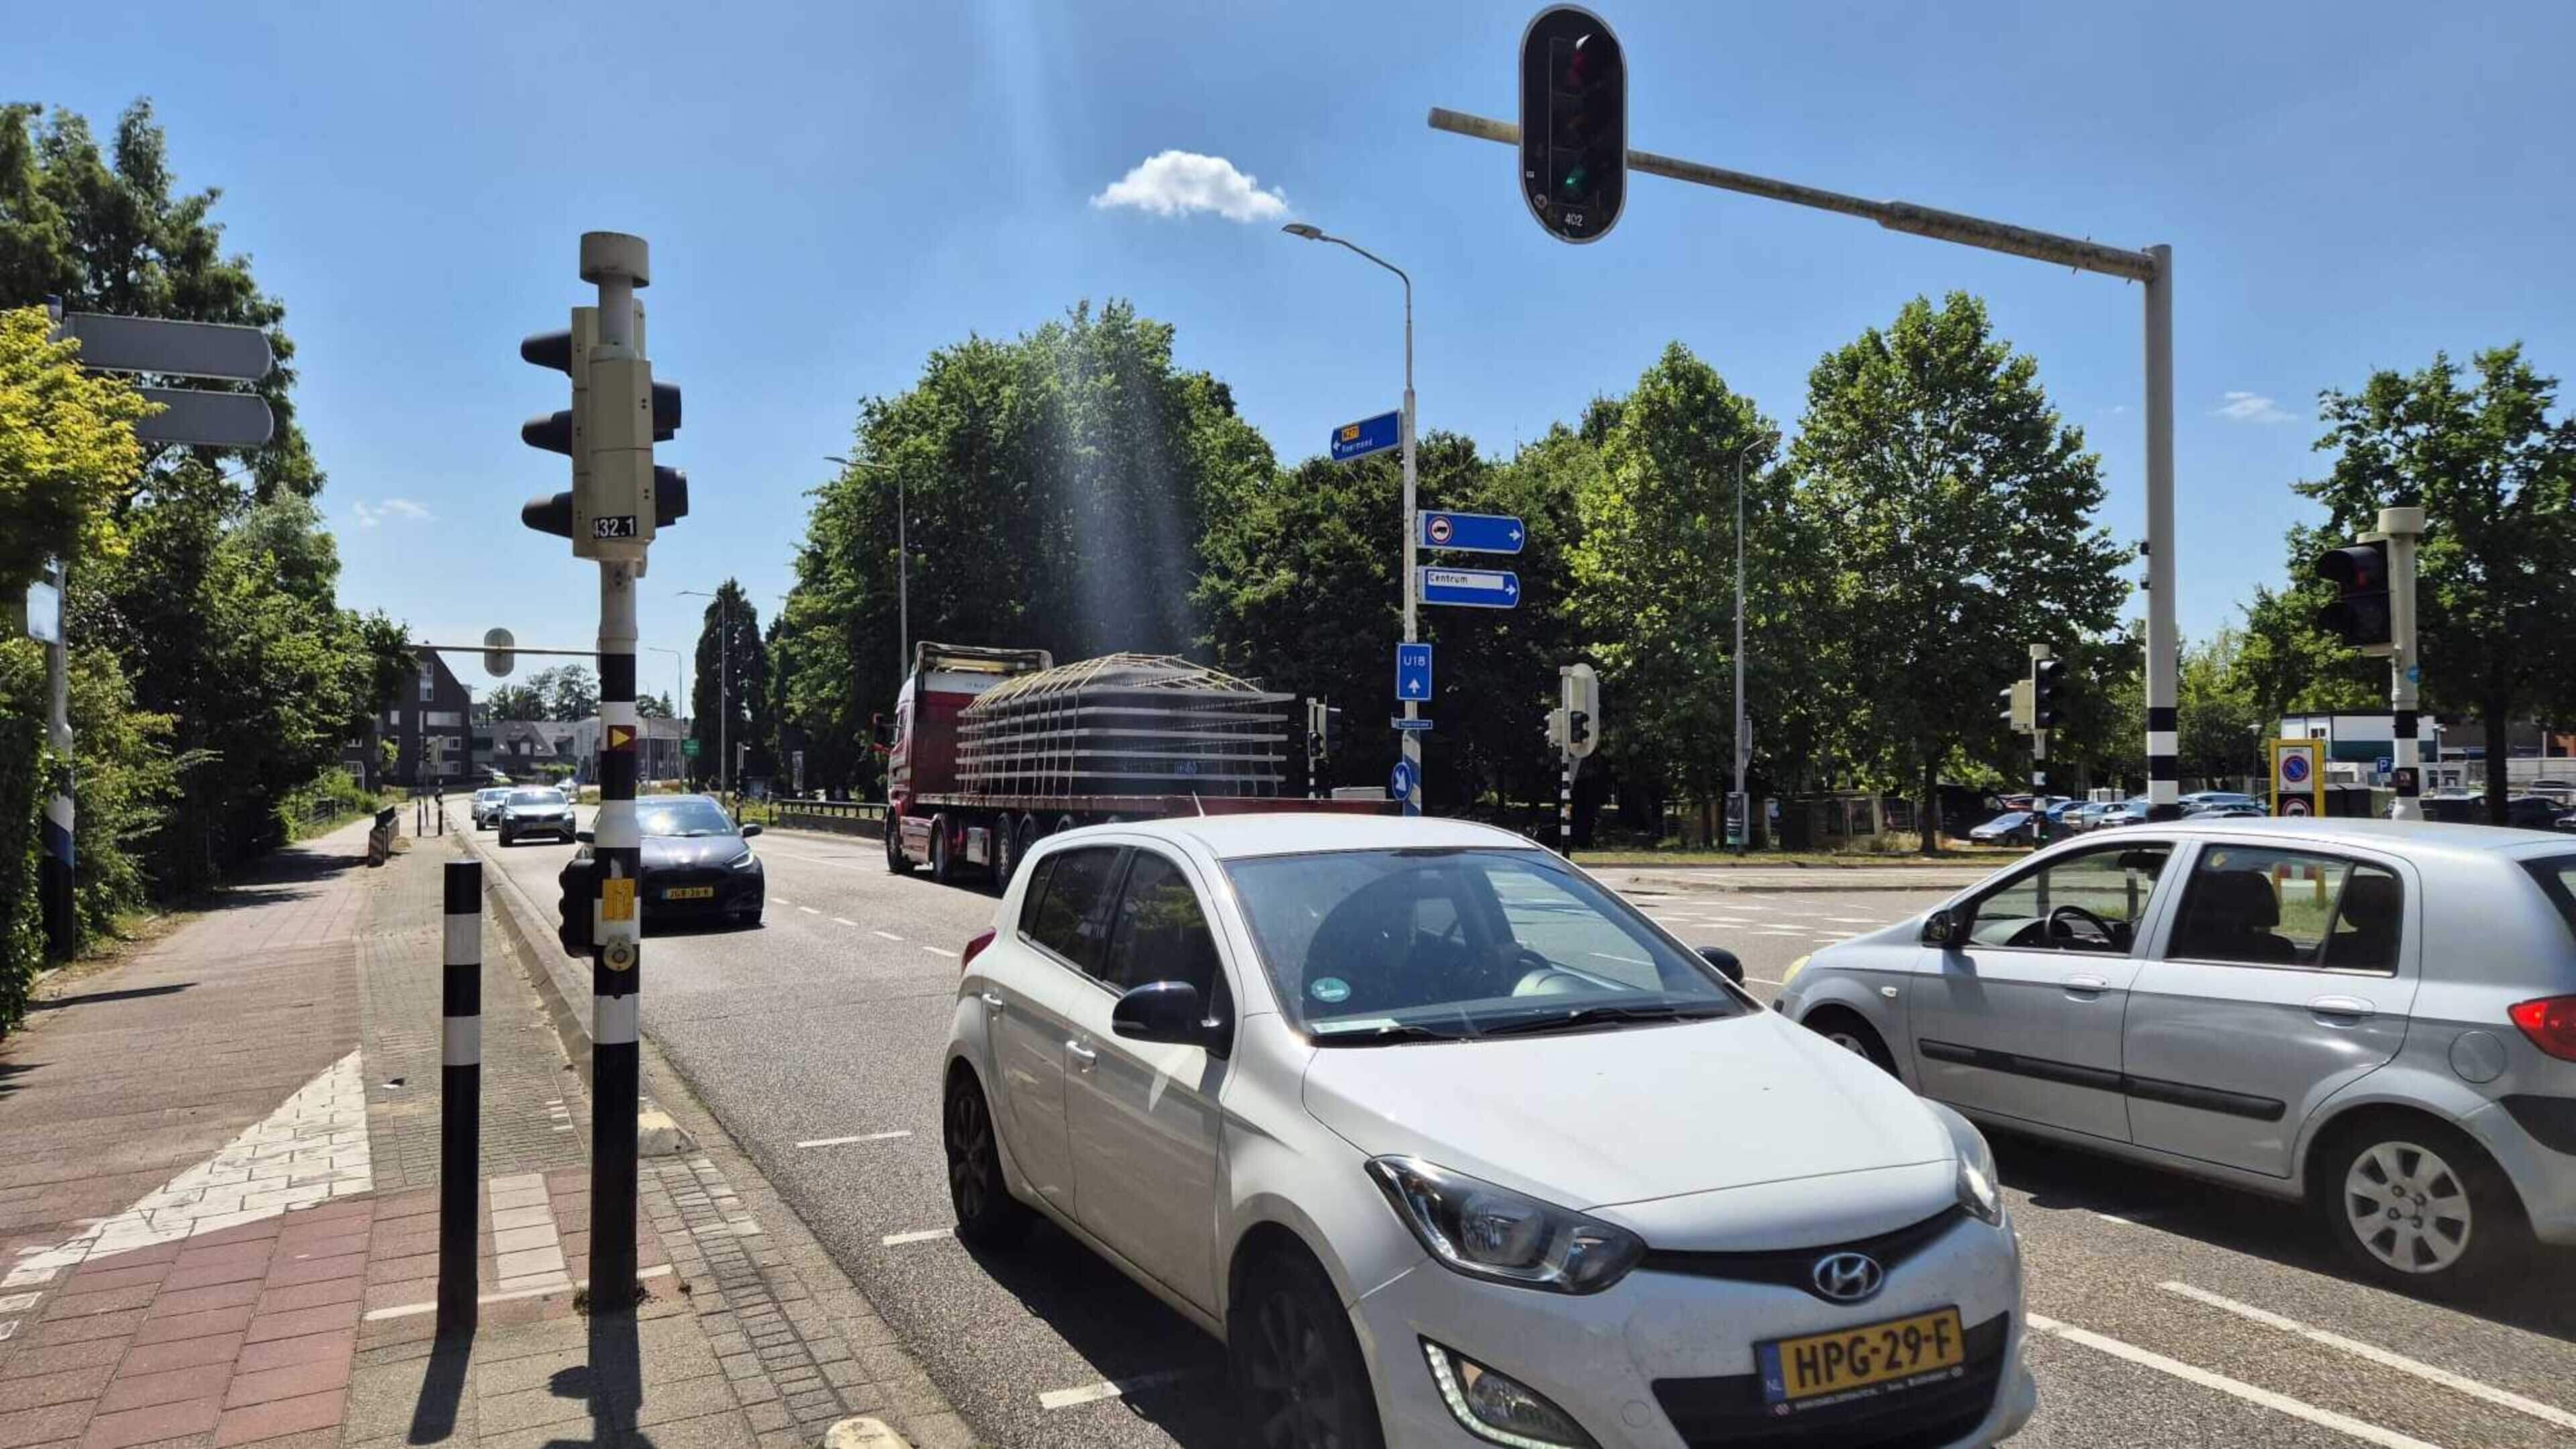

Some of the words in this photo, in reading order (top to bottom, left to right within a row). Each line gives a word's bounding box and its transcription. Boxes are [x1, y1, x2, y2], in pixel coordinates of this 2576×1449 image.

[1564, 213, 1583, 226] 402
[1430, 573, 1468, 584] Centrum
[1794, 1318, 1951, 1389] HPG-29-F
